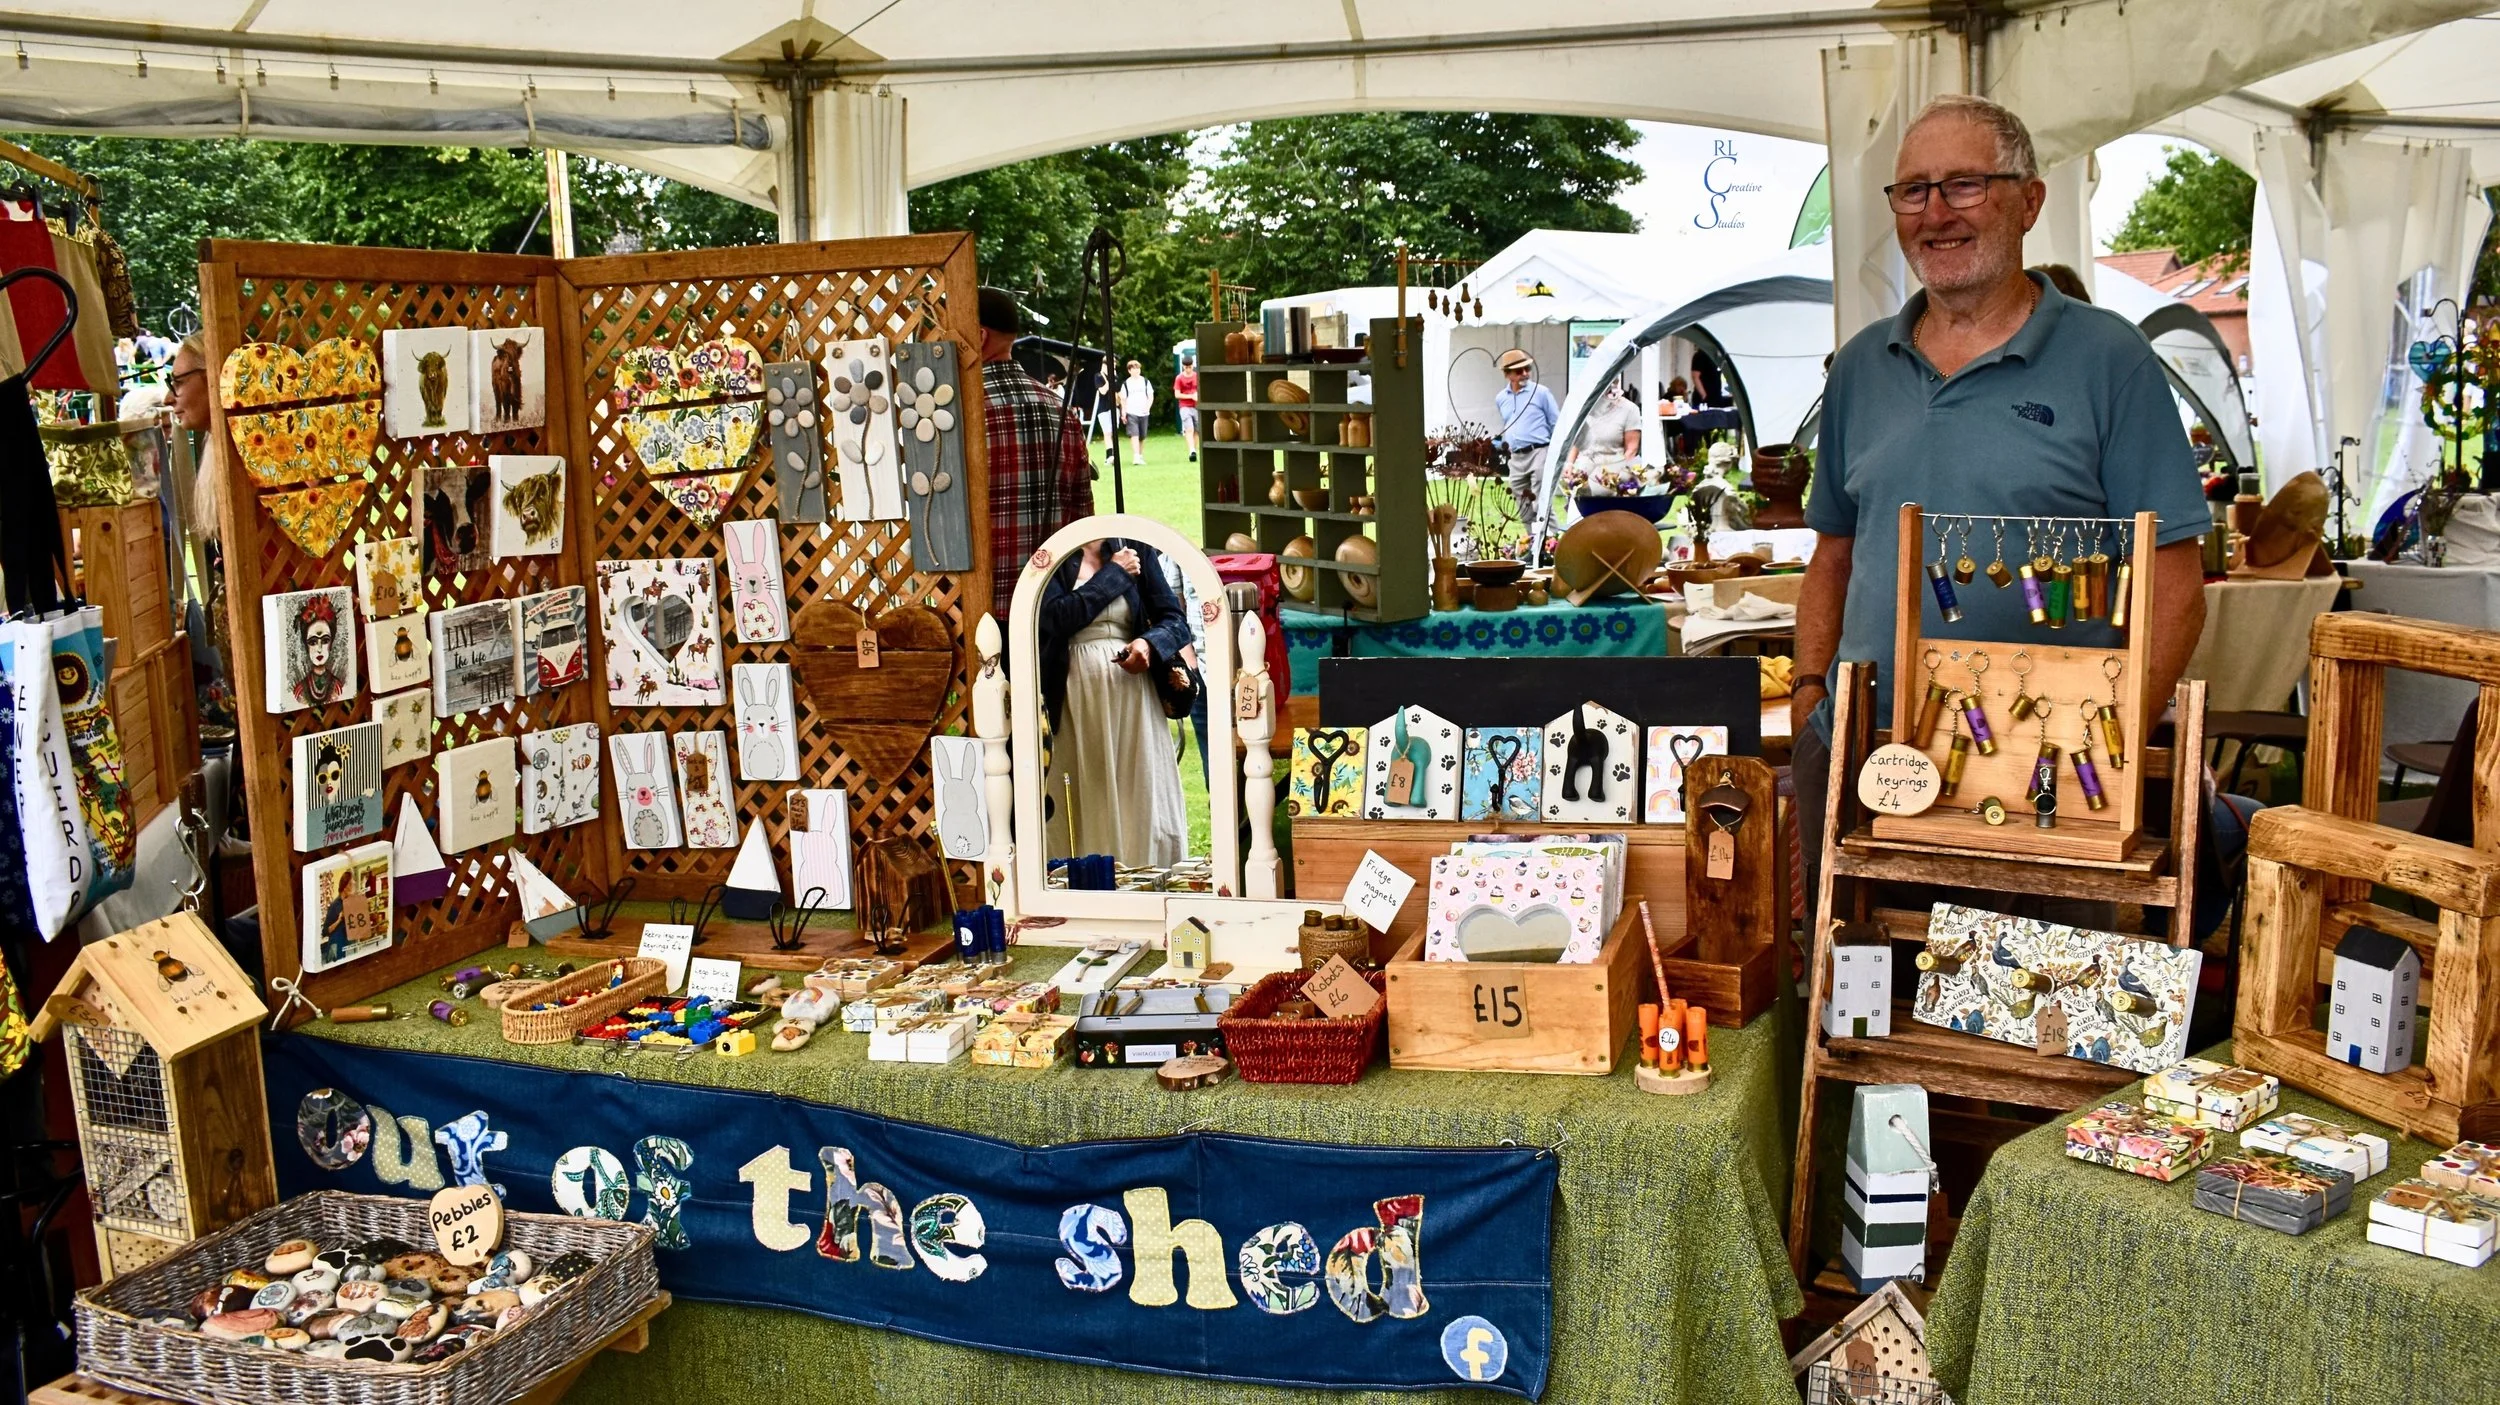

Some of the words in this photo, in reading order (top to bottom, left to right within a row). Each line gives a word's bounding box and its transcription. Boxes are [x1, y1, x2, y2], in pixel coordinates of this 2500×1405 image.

[375, 586, 396, 601] £10
[862, 638, 876, 656] £16
[453, 652, 469, 669] the
[472, 650, 488, 666] life
[391, 670, 402, 680] bee
[404, 666, 423, 680] happy
[1241, 684, 1254, 712] £28
[1870, 754, 1929, 775] Cartridge
[1390, 773, 1406, 788] £8
[1876, 772, 1928, 792] keyrings
[1878, 790, 1901, 810] £4
[470, 813, 480, 822] bee
[483, 809, 500, 820] happy
[1710, 845, 1732, 863] £14
[1366, 859, 1391, 884] Fridge
[1361, 893, 1372, 908] £1
[1364, 880, 1397, 907] magnets
[347, 913, 367, 930] £8
[645, 929, 661, 938] Retro
[643, 942, 669, 952] keyrings
[672, 940, 682, 950] £4
[2065, 942, 2079, 951] RED
[695, 968, 708, 979] Lego
[713, 967, 730, 978] brick
[1307, 964, 1345, 997] Robots
[171, 994, 188, 1004] bee
[194, 980, 217, 998] happy
[691, 983, 718, 998] keyring
[721, 982, 735, 994] £2
[1328, 988, 1349, 1009] £6
[68, 1002, 99, 1027] £30
[1474, 984, 1522, 1028] £15
[1661, 1031, 1677, 1045] £4
[2042, 1025, 2066, 1044] £18
[297, 1087, 508, 1199] out
[551, 1135, 695, 1250] of
[738, 1144, 988, 1283] the
[1055, 1186, 1430, 1323] shed
[432, 1193, 492, 1231] Pebbles
[452, 1225, 479, 1251] £2
